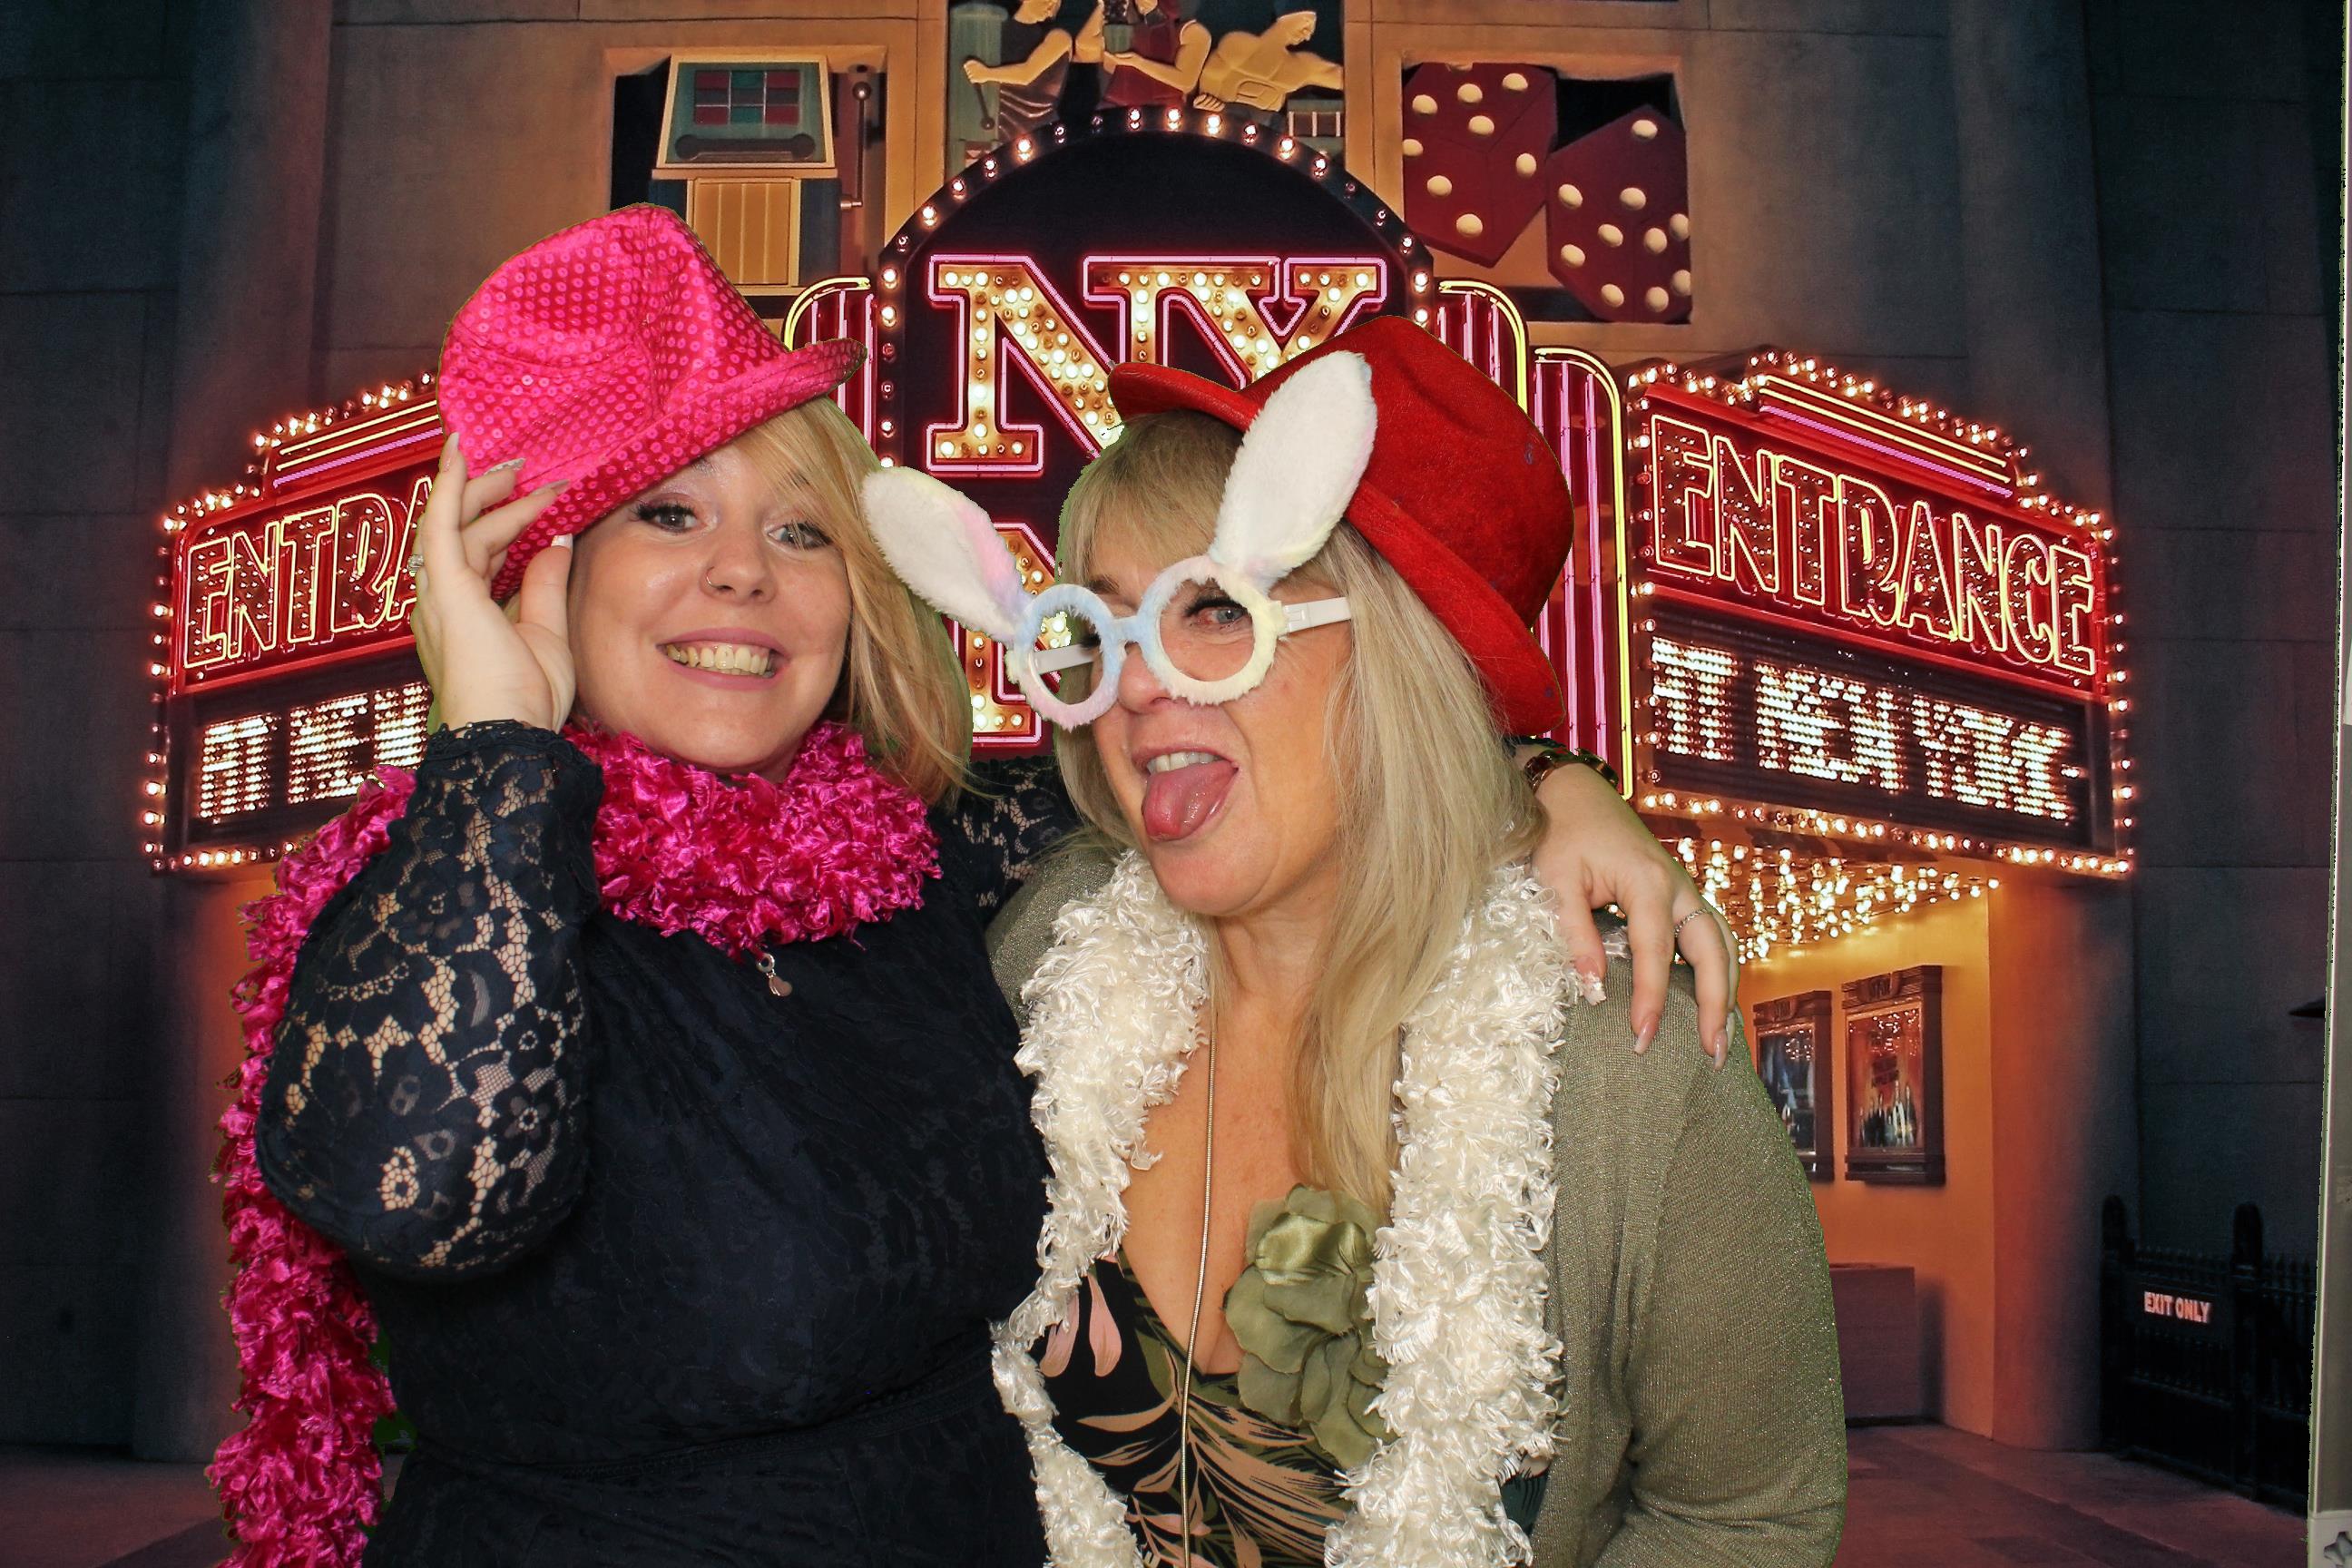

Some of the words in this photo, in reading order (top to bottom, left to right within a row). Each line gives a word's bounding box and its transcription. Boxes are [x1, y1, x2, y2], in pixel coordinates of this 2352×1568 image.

[183, 475, 431, 670] ENTRA
[1651, 413, 2097, 676] ENTRANCE
[2143, 1290, 2173, 1317] EXIT
[2175, 1297, 2210, 1323] ONLY
